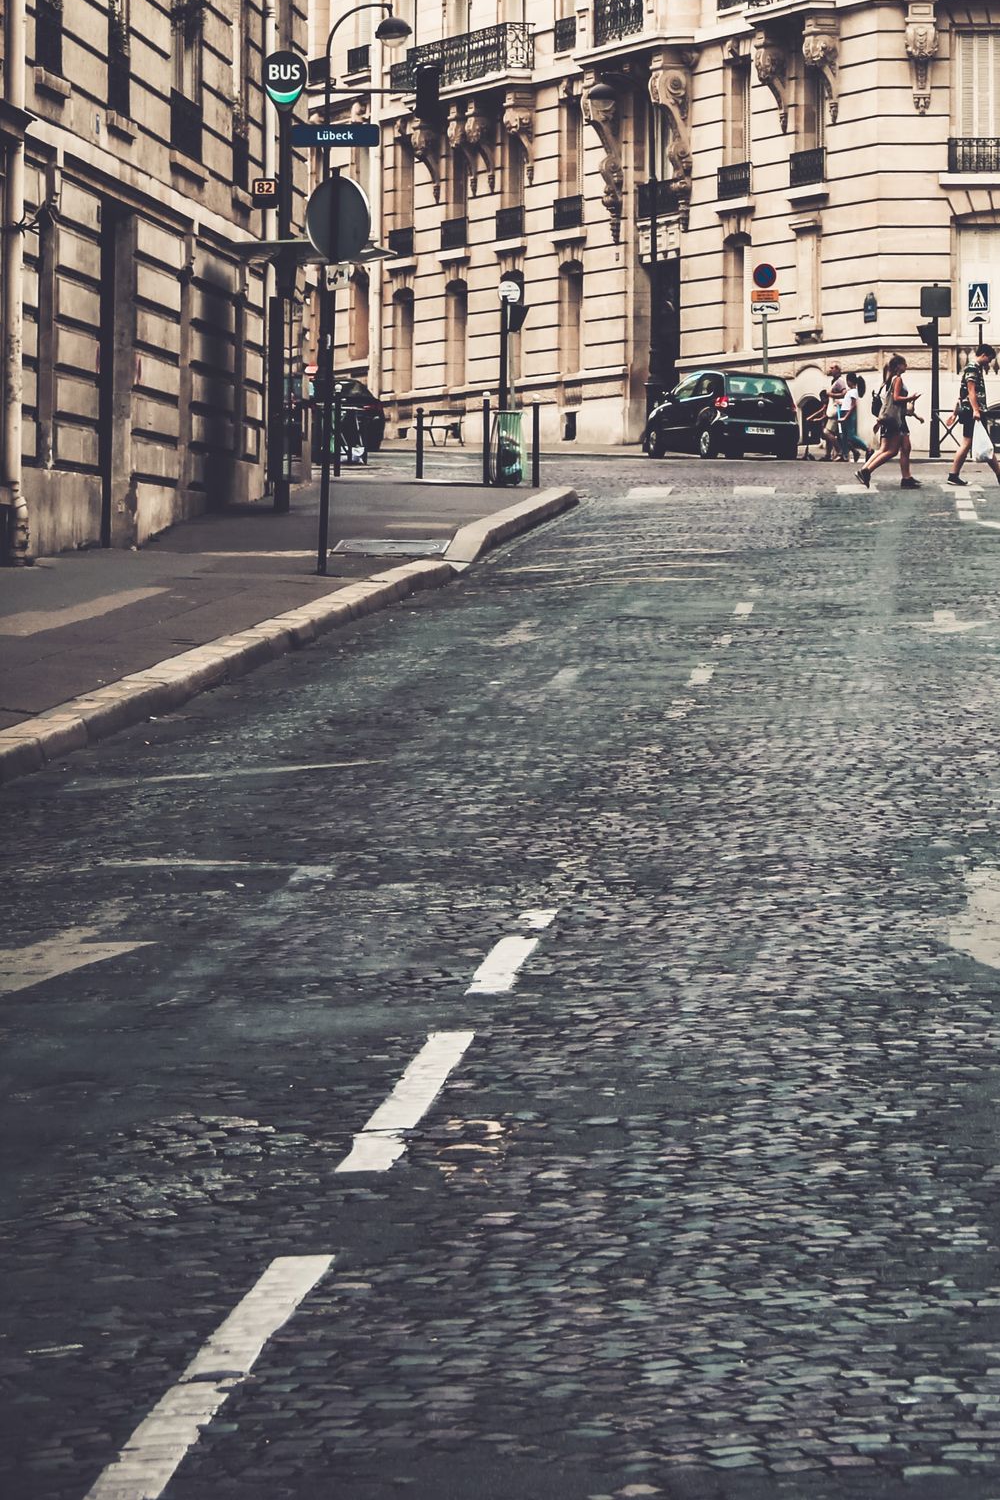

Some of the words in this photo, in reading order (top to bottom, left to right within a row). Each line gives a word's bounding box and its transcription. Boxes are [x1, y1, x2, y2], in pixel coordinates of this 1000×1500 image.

[269, 64, 300, 80] BUS
[317, 131, 353, 141] Lübeck
[257, 183, 272, 193] 82
